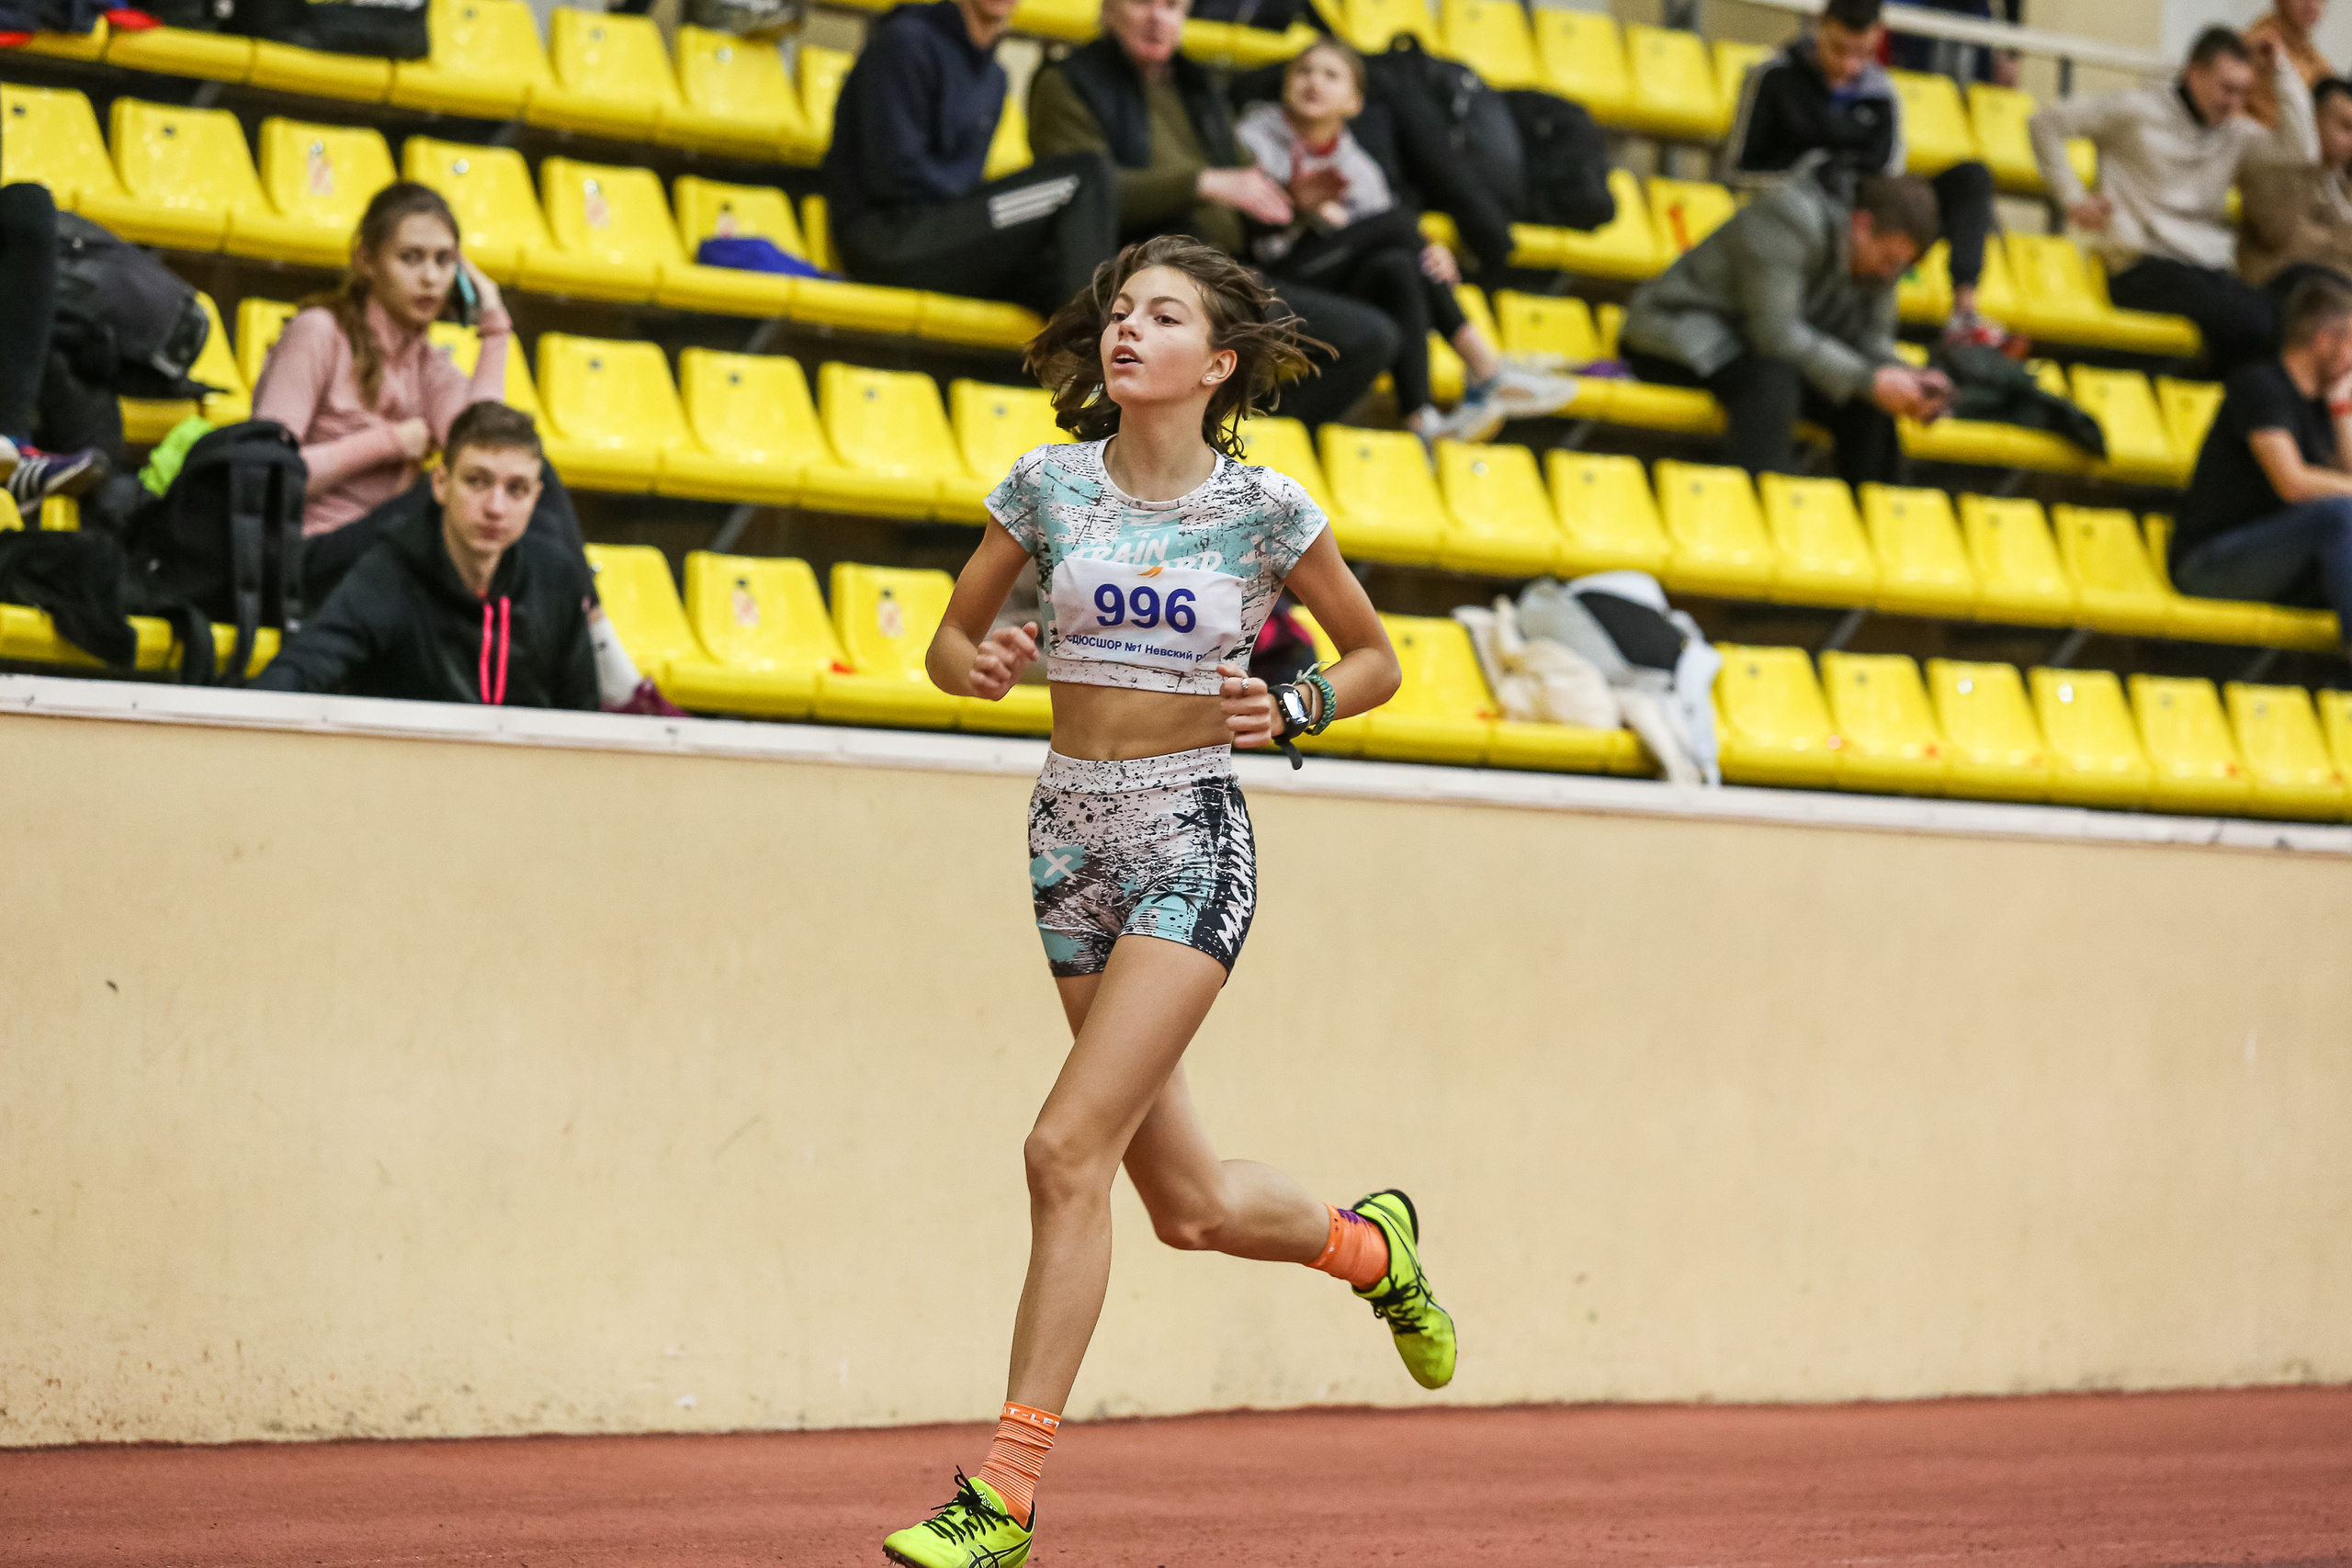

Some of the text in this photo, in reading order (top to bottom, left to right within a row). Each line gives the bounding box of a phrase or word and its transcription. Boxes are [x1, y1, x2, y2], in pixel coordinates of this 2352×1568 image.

[1093, 583, 1197, 634] 996
[1125, 642, 1142, 653] №1
[1145, 645, 1193, 660] Невский
[1216, 795, 1257, 955] MACHINE
